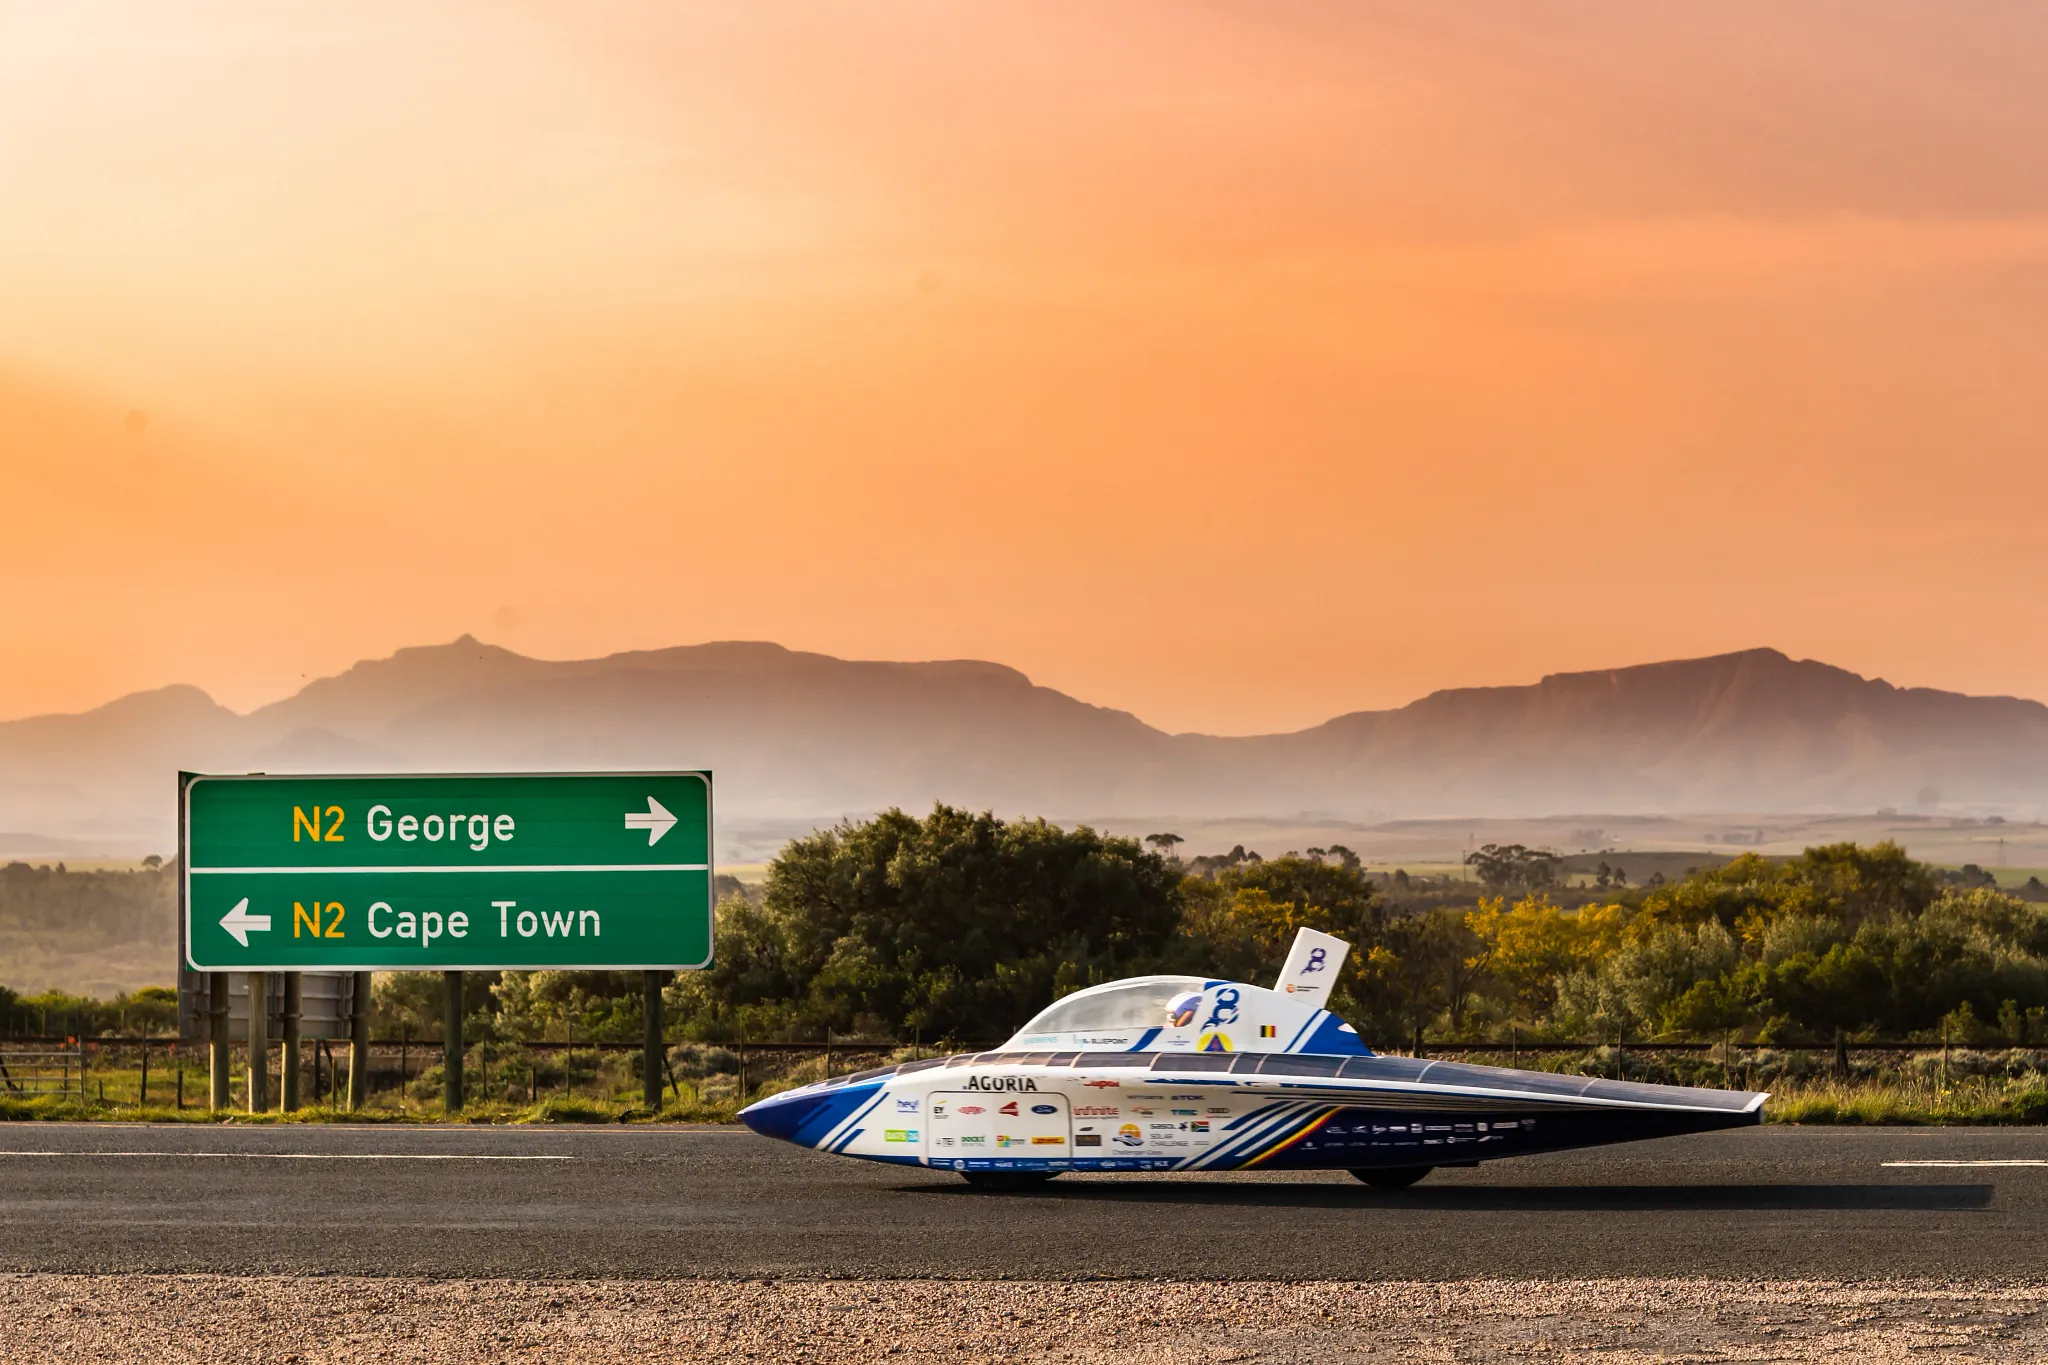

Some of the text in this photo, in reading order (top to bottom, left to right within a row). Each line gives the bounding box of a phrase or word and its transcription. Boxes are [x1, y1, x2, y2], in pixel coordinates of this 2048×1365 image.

[293, 804, 516, 851] N2 George
[293, 901, 601, 948] N2 Cape Town
[1073, 1106, 1120, 1116] infinite
